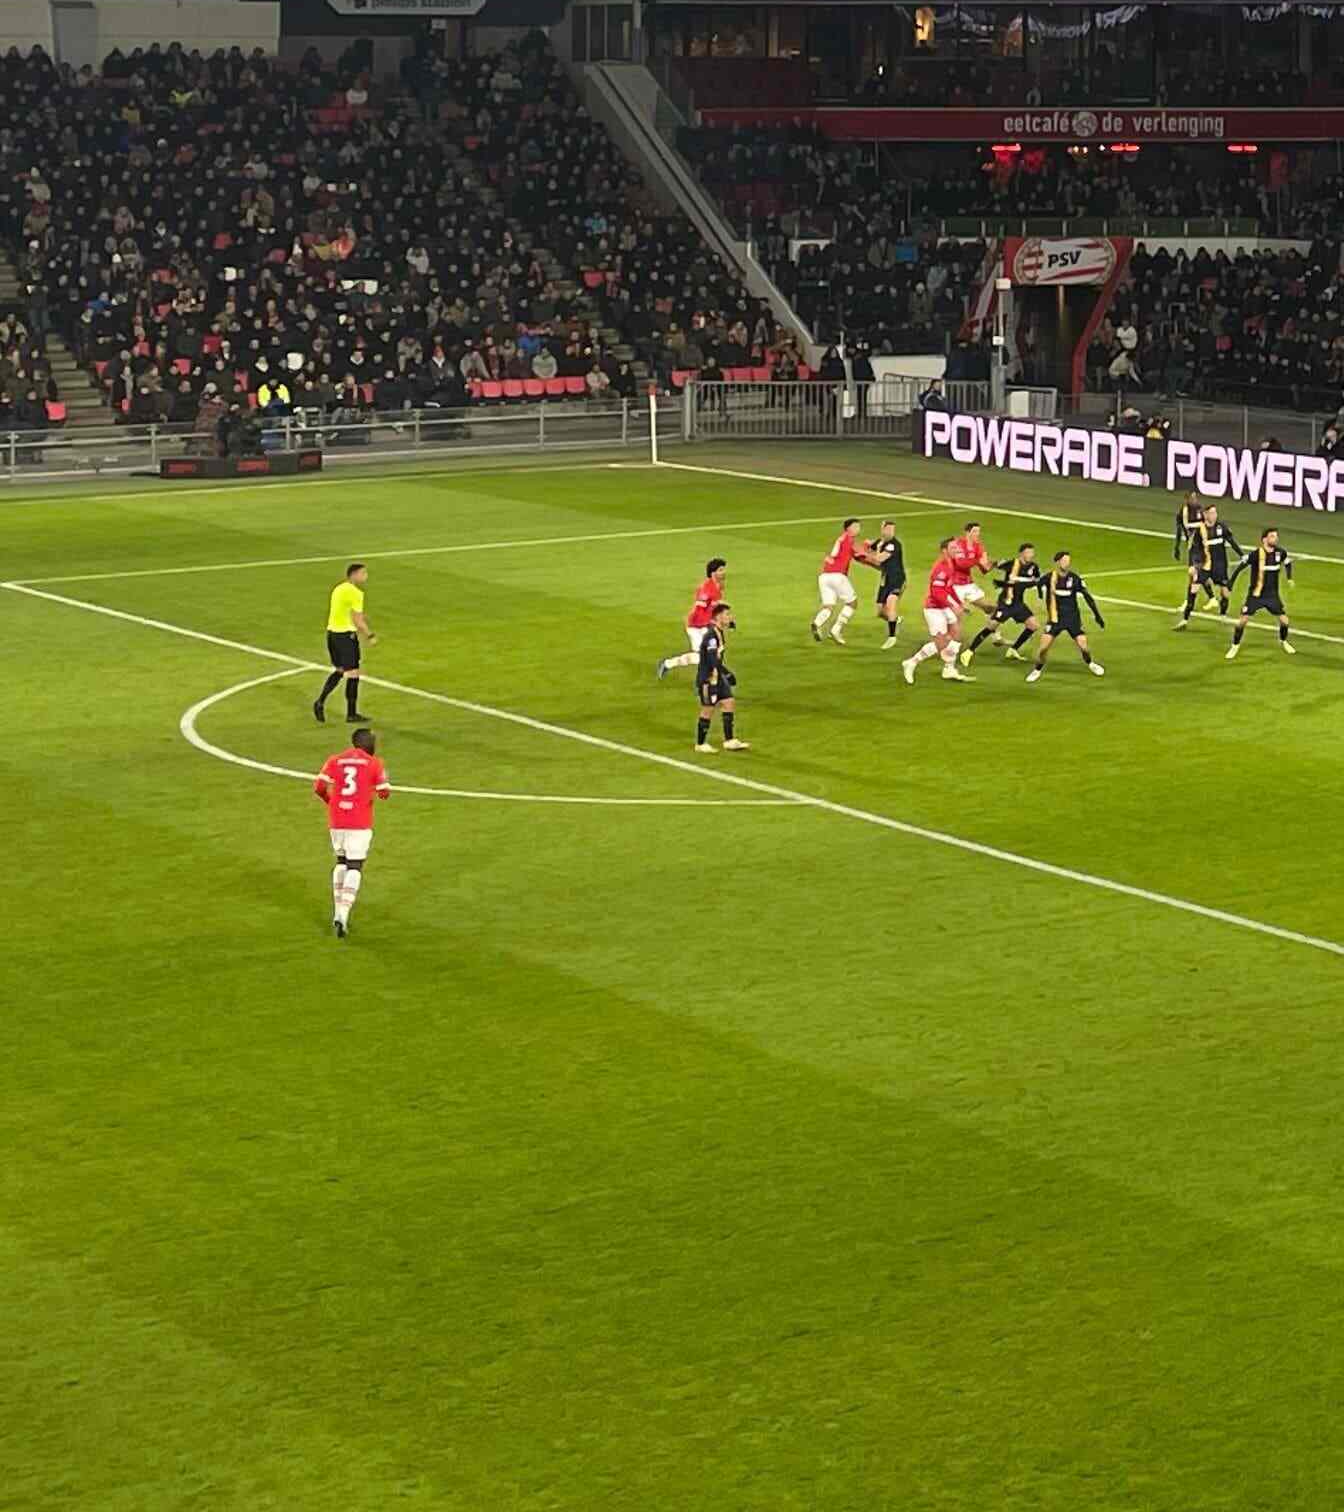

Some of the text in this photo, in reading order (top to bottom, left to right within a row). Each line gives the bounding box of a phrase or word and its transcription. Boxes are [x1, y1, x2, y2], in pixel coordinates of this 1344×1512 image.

[1003, 111, 1225, 137] eetcafé de verlenging
[1047, 250, 1082, 268] PSV
[925, 410, 1147, 486] POWERADE
[340, 765, 358, 796] 3
